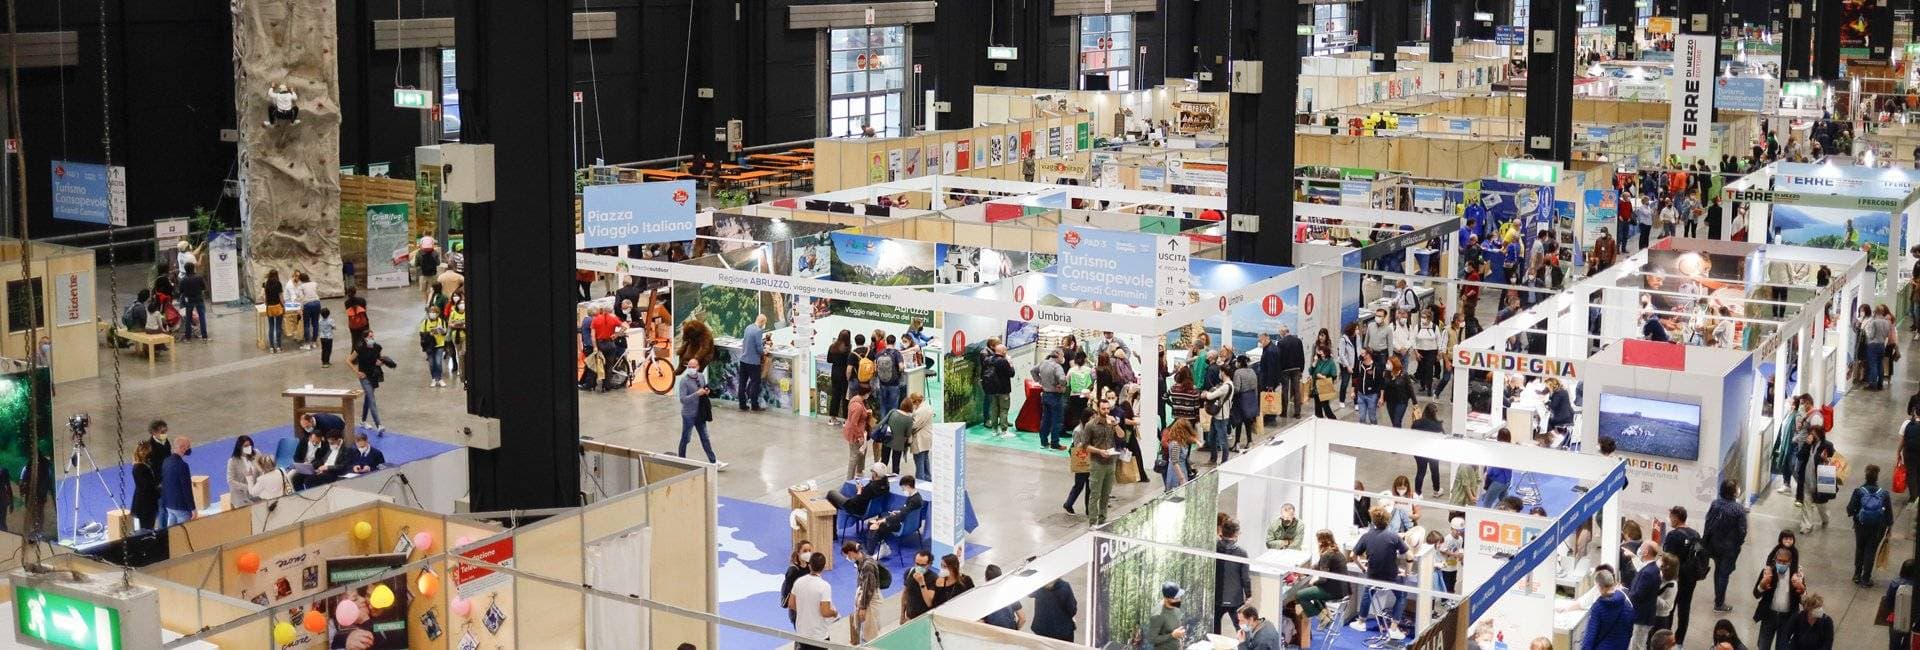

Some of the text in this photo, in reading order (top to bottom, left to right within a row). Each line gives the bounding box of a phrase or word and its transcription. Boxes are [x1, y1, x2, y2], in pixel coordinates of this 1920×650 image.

[1686, 39, 1694, 66] MEZZO
[1682, 80, 1700, 151] TERRE
[55, 181, 87, 195] Turismo
[1726, 189, 1773, 202] TERRE
[1862, 198, 1897, 207] PERCORSI
[587, 209, 633, 223] Piazza
[587, 219, 693, 240] Viaggio Italiano
[1061, 250, 1117, 270] Turismo
[1158, 252, 1187, 262] USCITA
[1061, 265, 1154, 288] Consapevole
[718, 273, 748, 285] Regione
[793, 284, 817, 294] viaggio
[817, 286, 833, 294] nella
[834, 287, 857, 297] Natura
[869, 291, 892, 301] Parchi
[1069, 282, 1102, 295] Grandi
[1104, 285, 1148, 300] Cammini
[844, 305, 865, 317] Viaggio
[866, 308, 880, 317] nella
[880, 310, 901, 320] natura
[894, 304, 929, 316] Abruzzo
[1037, 310, 1072, 323] Umbria
[1457, 350, 1577, 379] SARDEGNA
[1624, 457, 1680, 474] ARDEGNA
